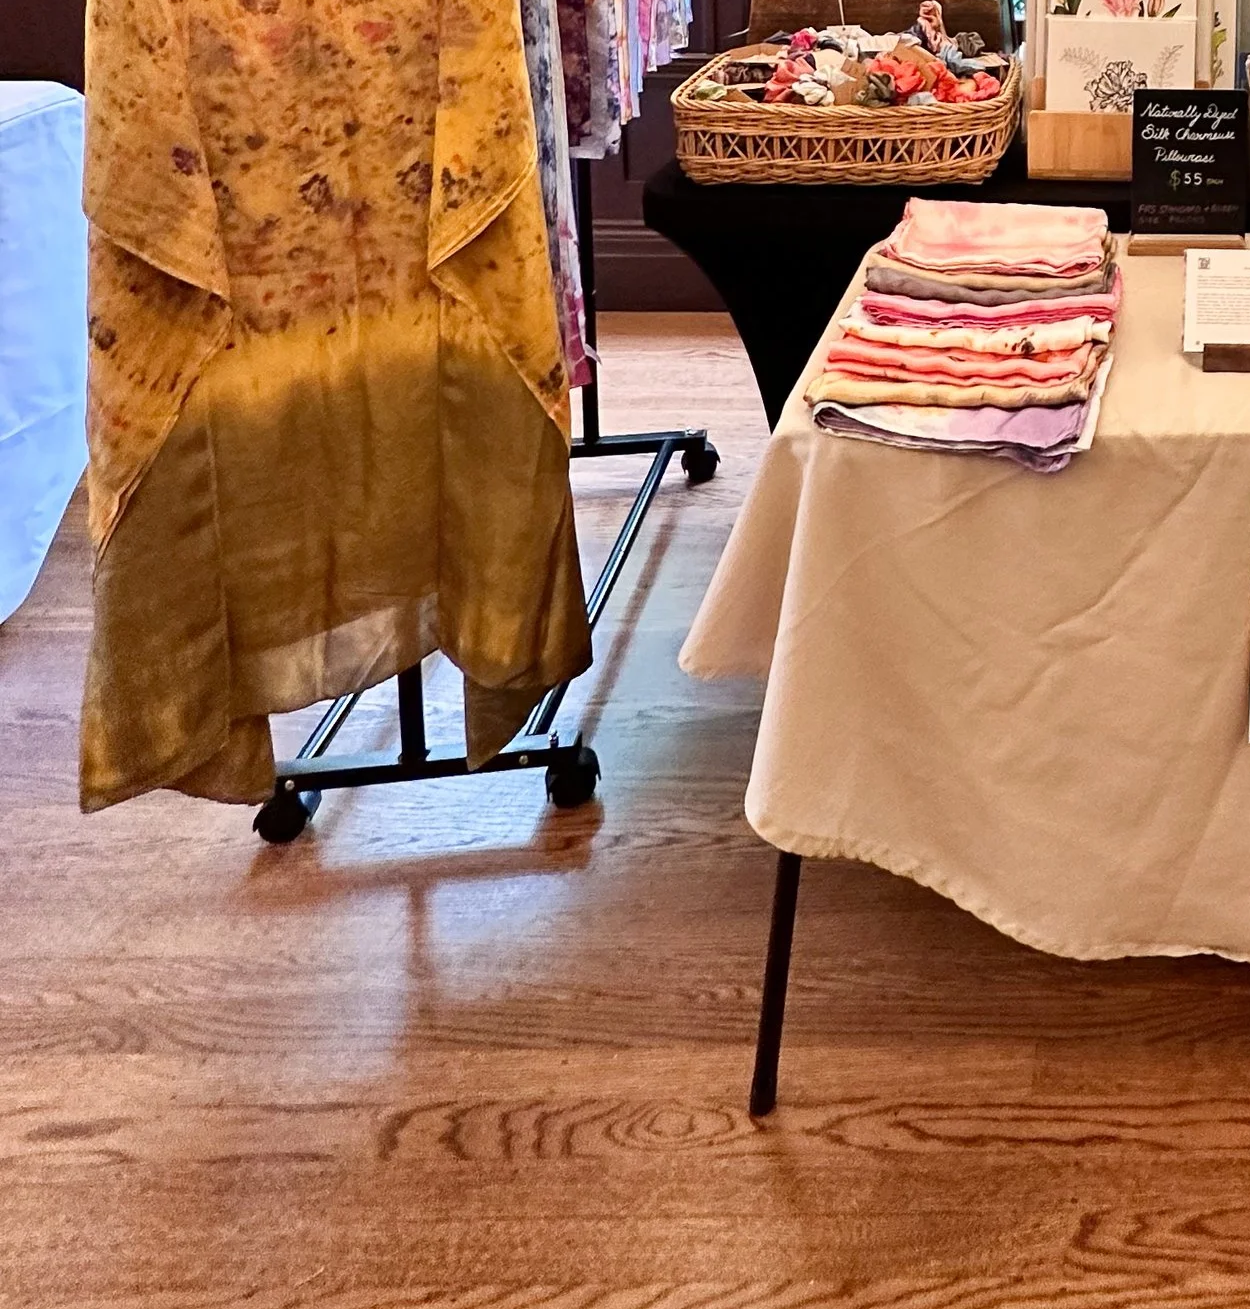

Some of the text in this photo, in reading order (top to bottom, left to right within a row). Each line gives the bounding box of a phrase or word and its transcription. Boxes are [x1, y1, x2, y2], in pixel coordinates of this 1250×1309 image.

[1140, 102, 1239, 130] Naturally Dyed
[1141, 123, 1235, 140] Silk Charmeuse
[1153, 146, 1216, 163] Pillowcase
